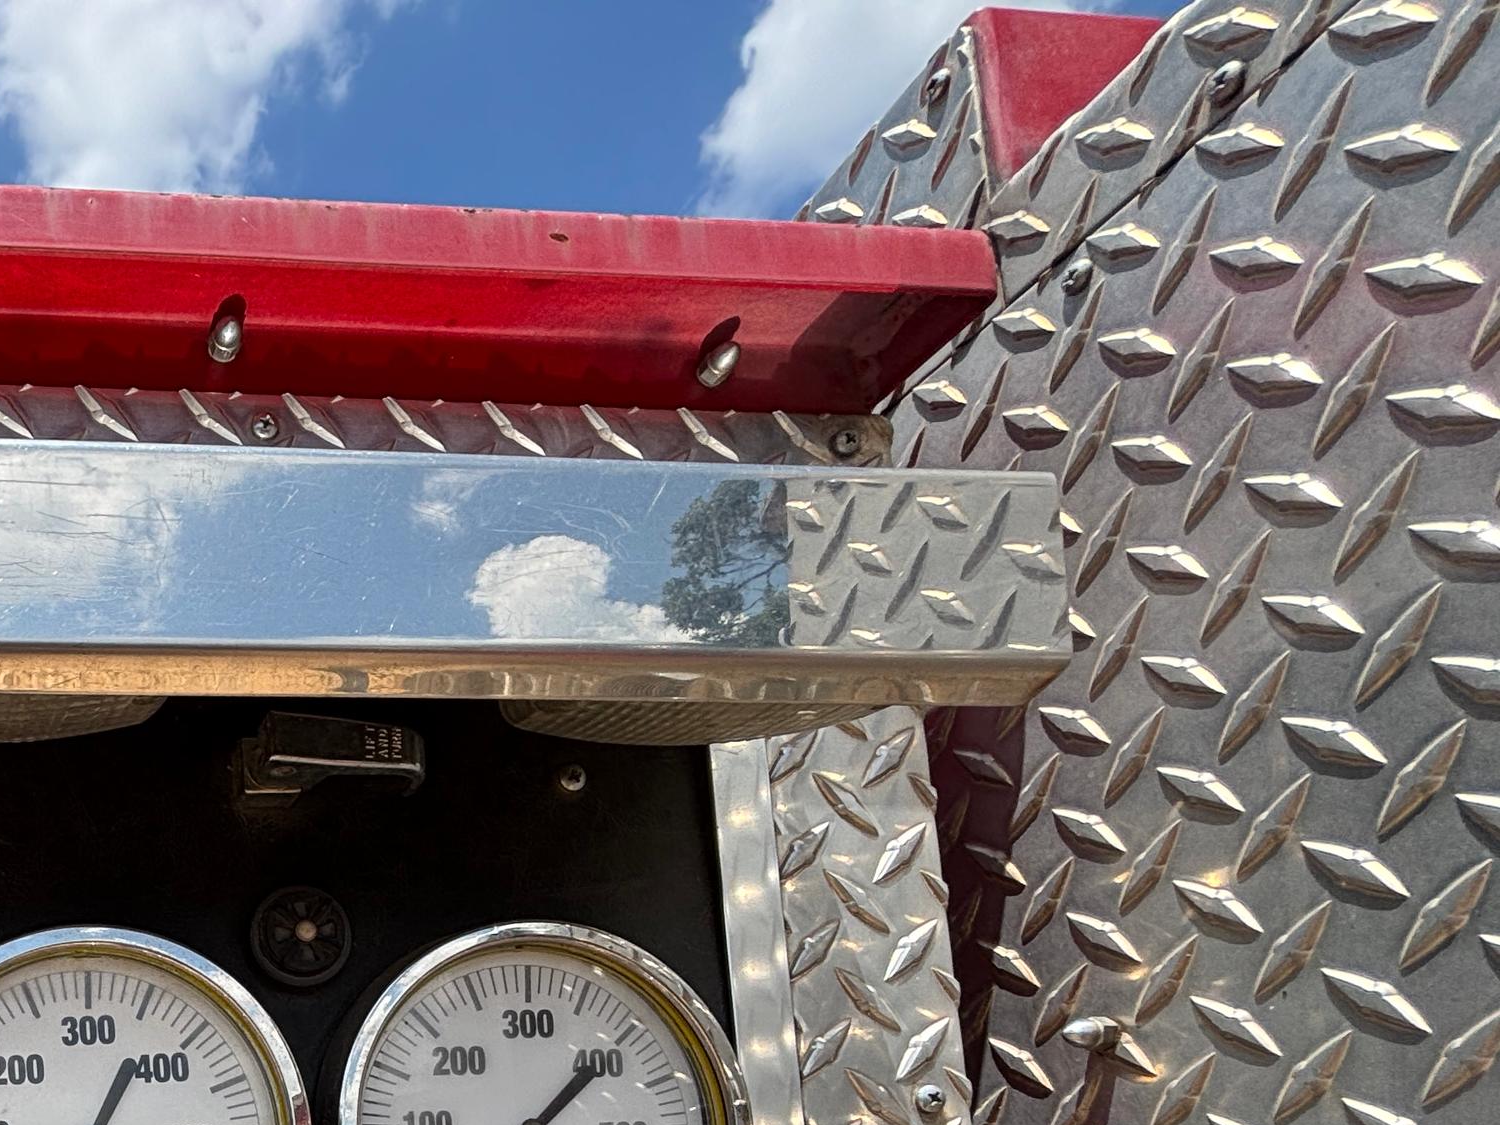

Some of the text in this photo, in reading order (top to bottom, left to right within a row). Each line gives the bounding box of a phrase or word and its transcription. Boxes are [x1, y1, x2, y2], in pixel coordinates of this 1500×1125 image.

[378, 729, 389, 759] AND
[60, 1014, 116, 1046] 300
[502, 1009, 554, 1039] 300
[134, 1052, 190, 1083] 400
[432, 1046, 486, 1076] 200
[572, 1047, 623, 1077] 400
